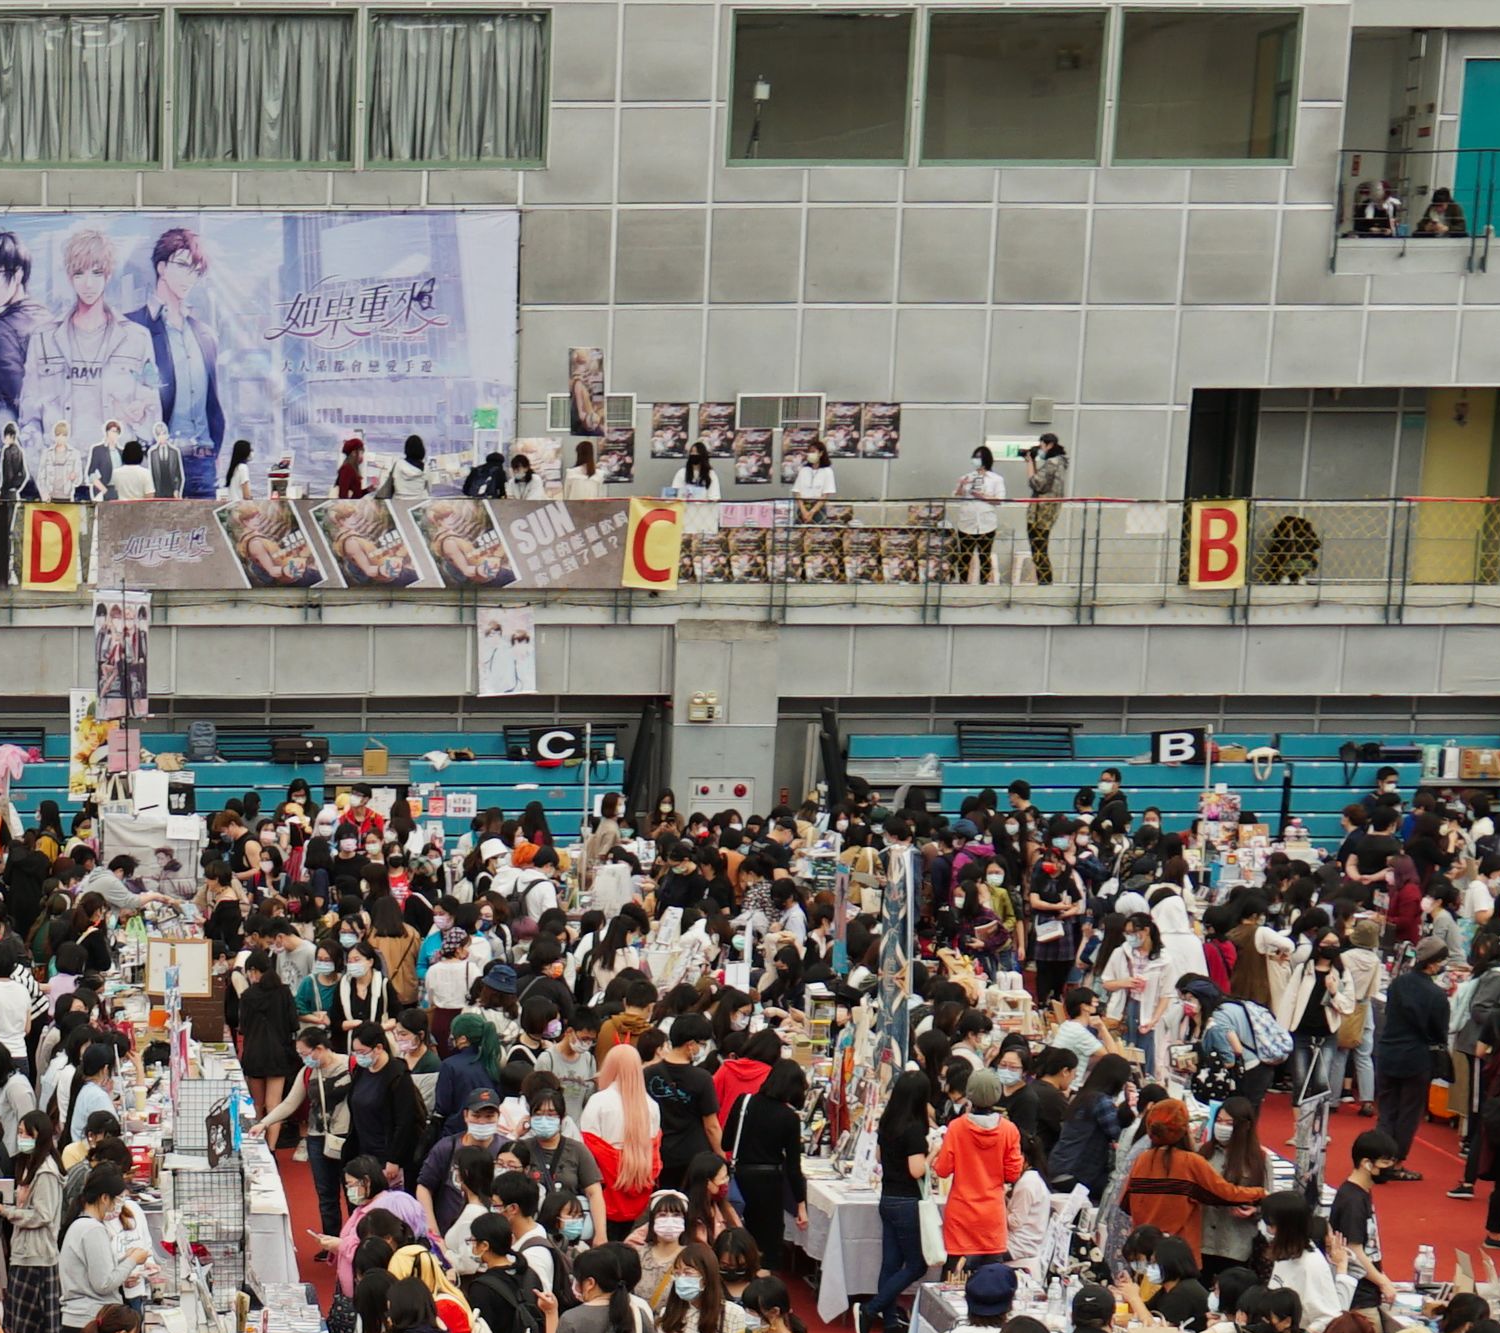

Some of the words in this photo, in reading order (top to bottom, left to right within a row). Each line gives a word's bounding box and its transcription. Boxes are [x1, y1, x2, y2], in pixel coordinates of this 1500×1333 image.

[30, 509, 73, 584] D
[509, 501, 575, 555] SUN
[632, 508, 677, 582] C
[1198, 508, 1239, 582] B
[537, 730, 577, 760] C
[1158, 733, 1196, 764] B
